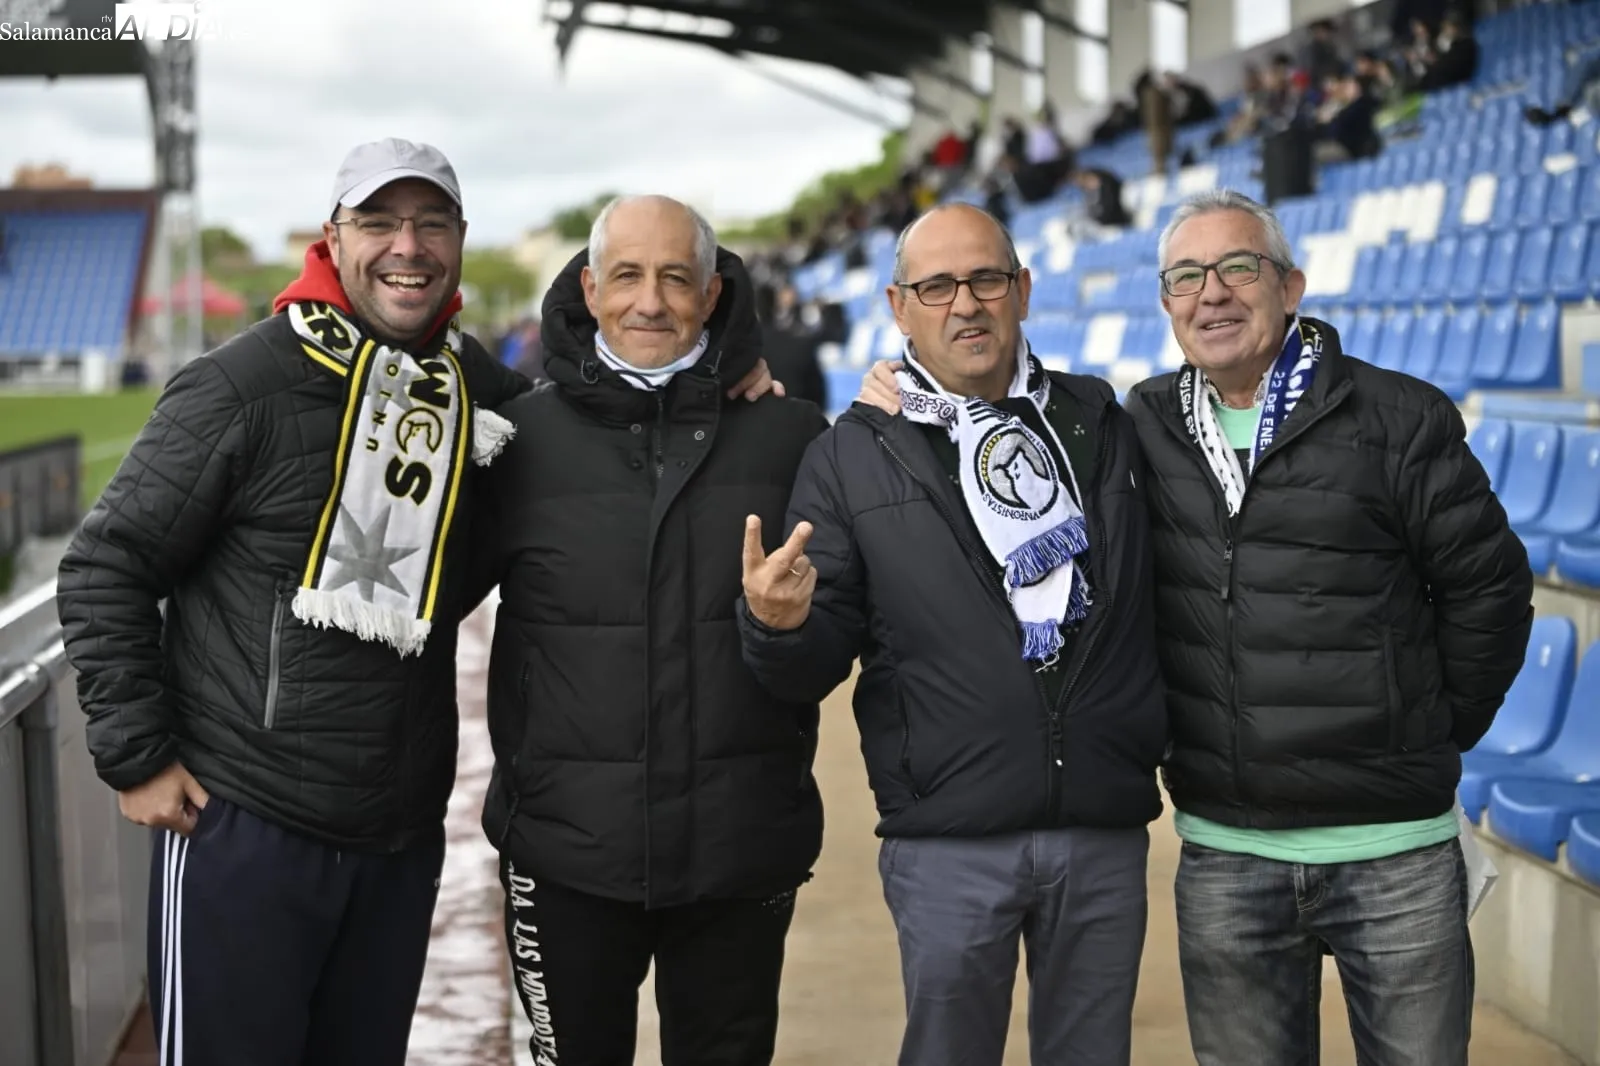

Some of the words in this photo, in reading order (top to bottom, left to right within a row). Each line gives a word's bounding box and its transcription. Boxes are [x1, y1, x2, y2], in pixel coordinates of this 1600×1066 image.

[1271, 370, 1286, 388] 22
[1264, 392, 1279, 413] DE
[1259, 417, 1275, 451] ENE
[512, 918, 542, 962] LAS
